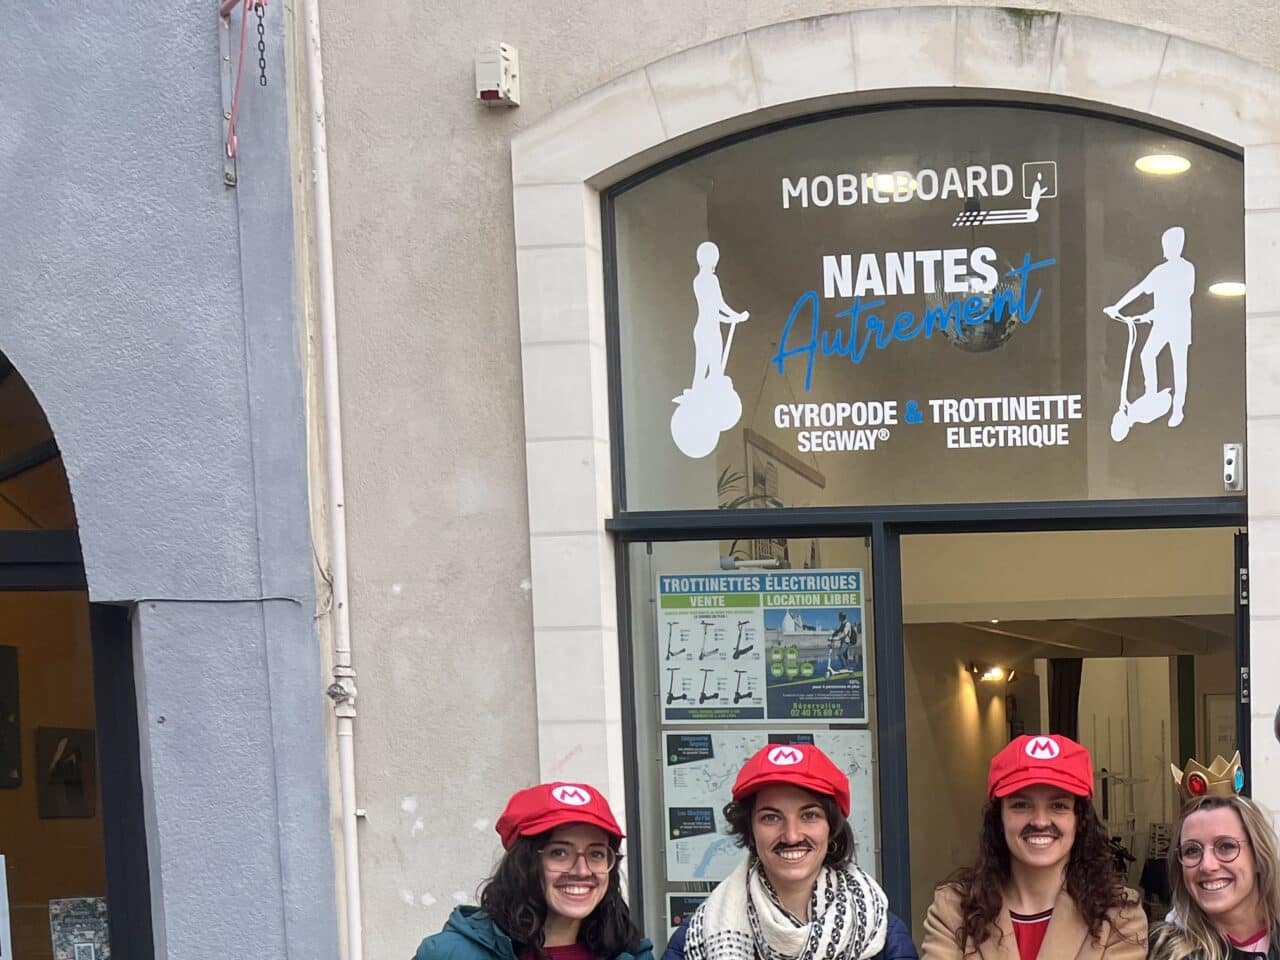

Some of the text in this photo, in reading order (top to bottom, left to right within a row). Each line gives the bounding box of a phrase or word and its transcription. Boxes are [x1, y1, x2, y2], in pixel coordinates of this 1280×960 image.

[782, 163, 1014, 209] MOBILBOARD
[822, 246, 999, 299] NANTES
[771, 252, 1057, 392] Autrement
[774, 394, 1082, 429] GYROPODE & TROTTINETTE
[946, 423, 1069, 449] ELECTRIQUE
[663, 572, 857, 592] TROTTINETTES ÉLECTRIQUES
[690, 595, 725, 607] VENTE
[766, 593, 857, 606] LOCATION LIBRE
